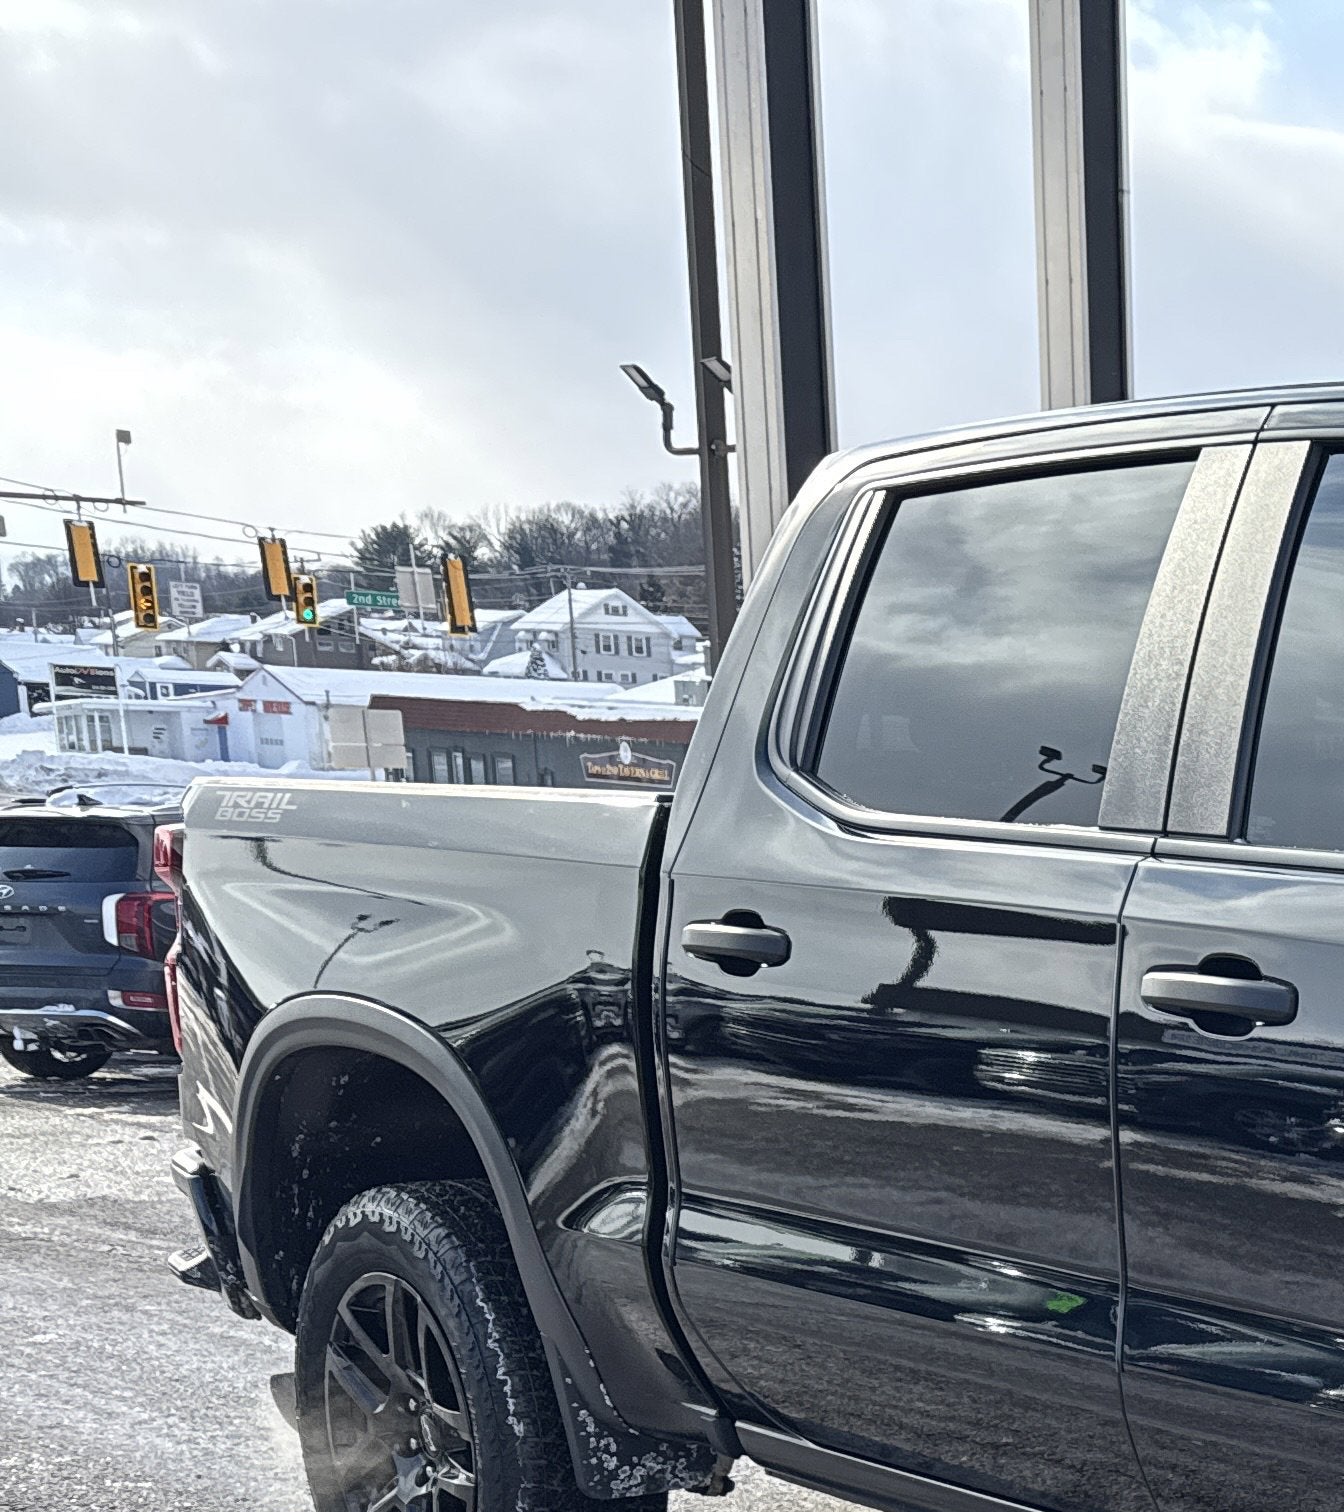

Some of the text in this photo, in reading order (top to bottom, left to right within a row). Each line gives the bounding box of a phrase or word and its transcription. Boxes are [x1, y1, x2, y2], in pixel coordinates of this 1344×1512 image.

[352, 593, 400, 607] 2nd Stre
[215, 790, 299, 810] TRAIL
[214, 807, 284, 823] BOSS
